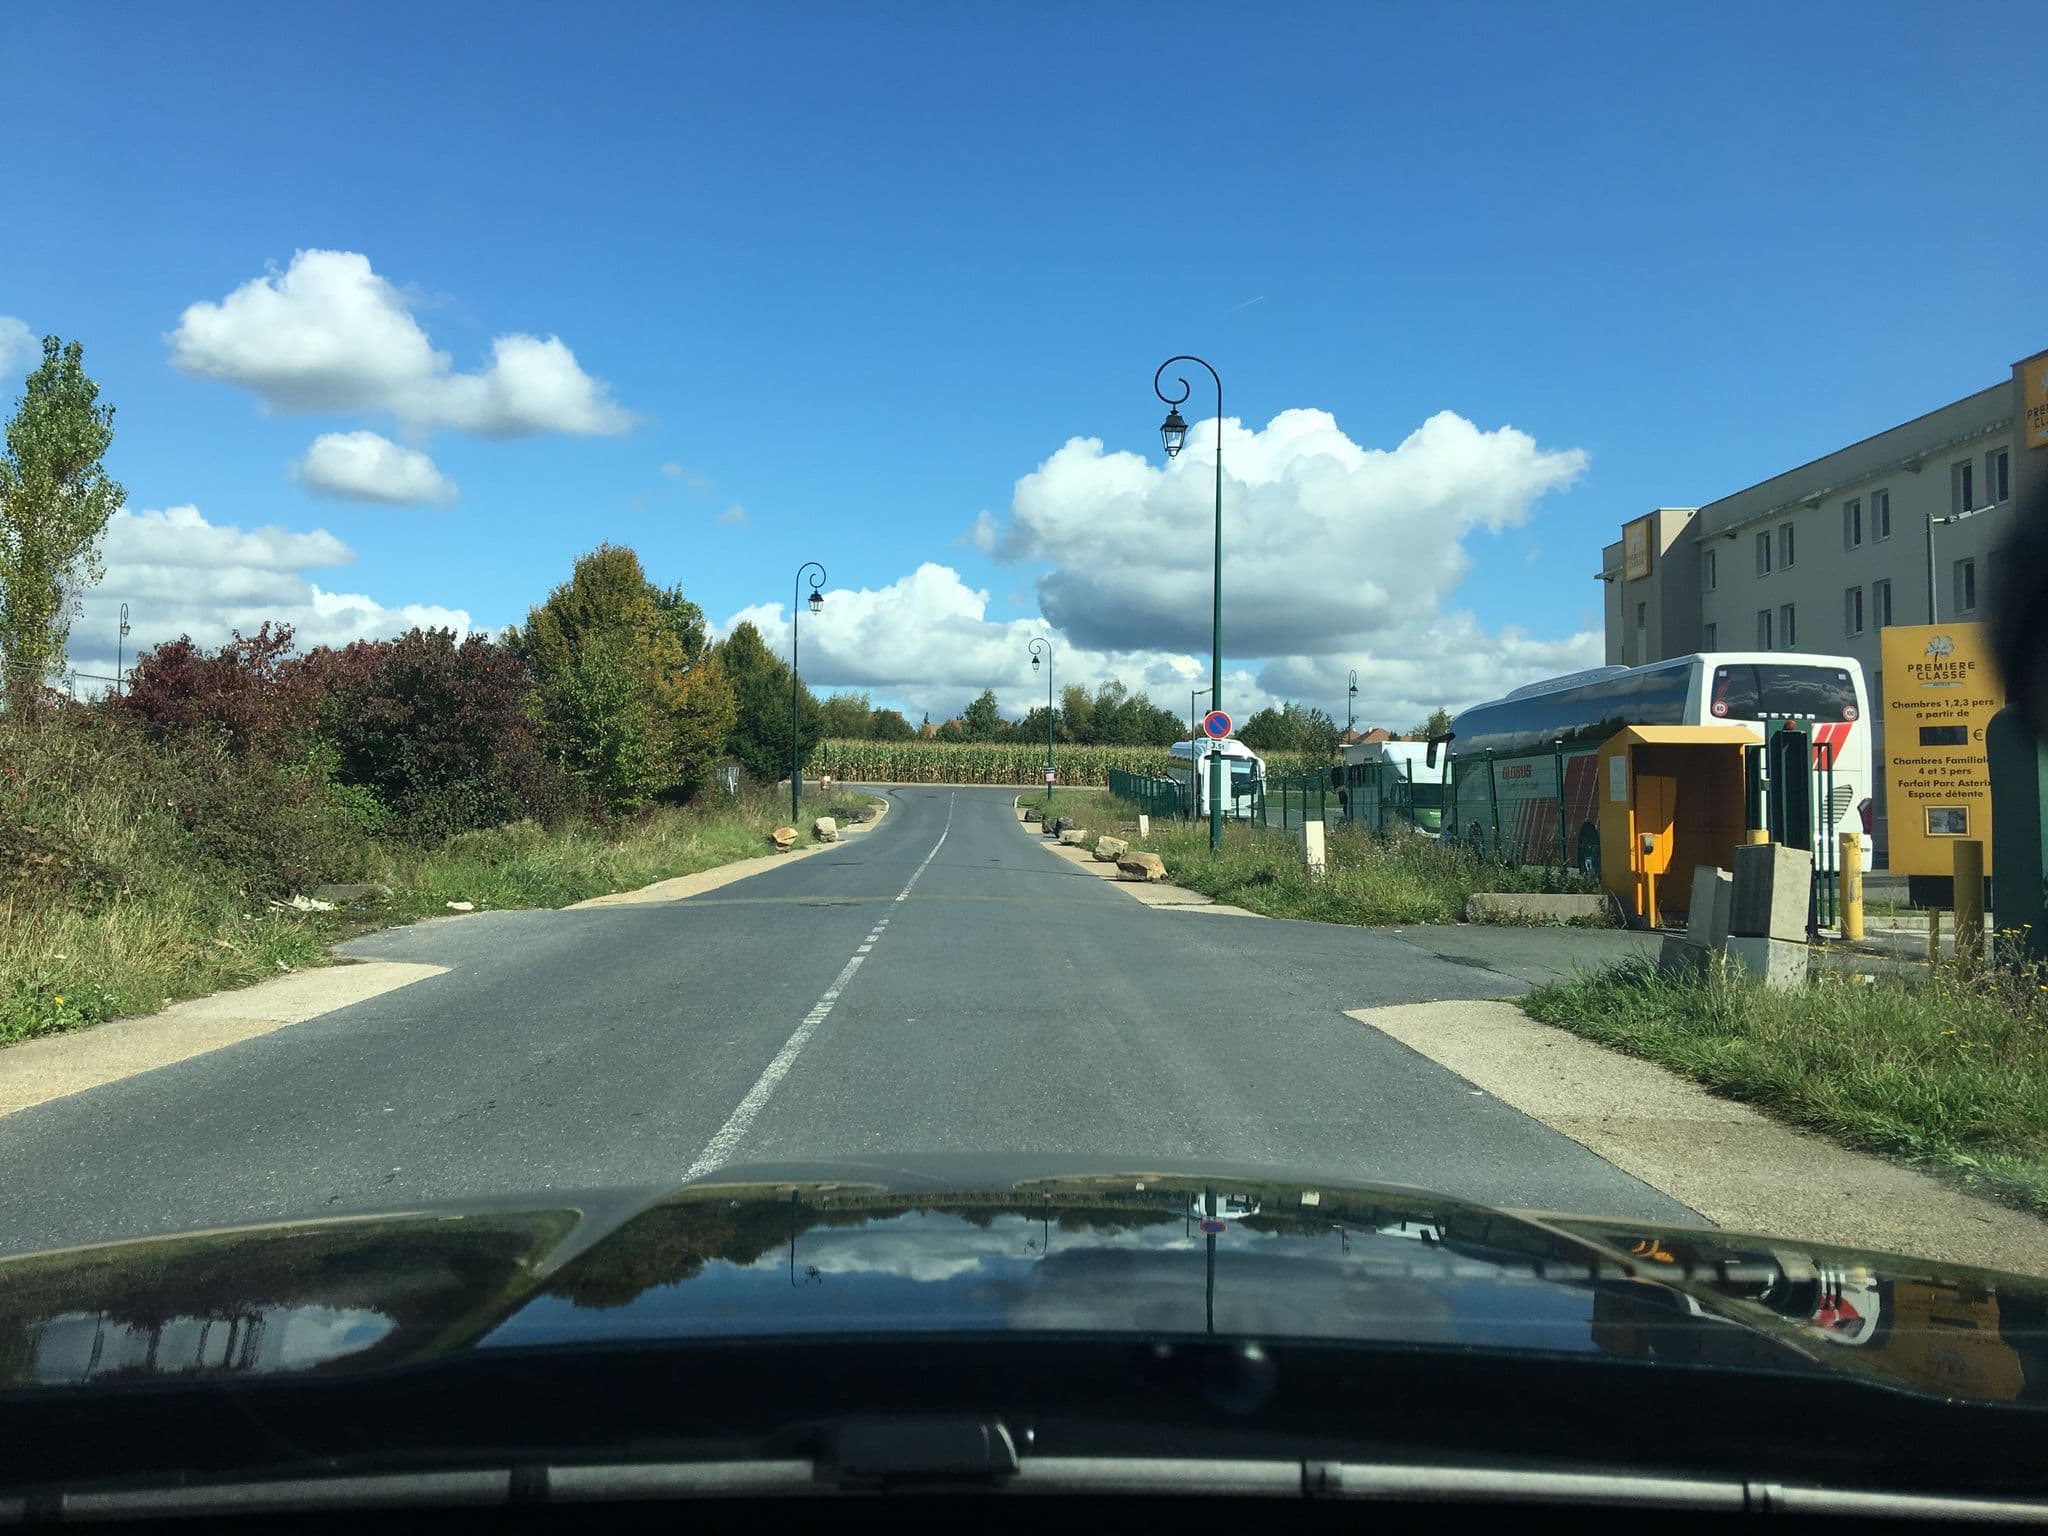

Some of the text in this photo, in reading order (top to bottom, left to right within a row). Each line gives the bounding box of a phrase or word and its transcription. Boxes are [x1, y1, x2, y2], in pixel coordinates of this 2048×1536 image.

[1907, 661, 1976, 672] PREMIERE
[1917, 671, 1967, 681] CLASSE
[1892, 699, 1994, 709] Chambres 1,2,3 pers
[1757, 712, 1816, 720] SETRA
[1926, 710, 1954, 719] partir
[1973, 728, 1983, 741] €
[1893, 755, 1988, 765] Chambres Familial
[1928, 767, 1938, 775] et
[1941, 767, 1947, 775] 5
[1949, 768, 1972, 777] pers
[1898, 779, 1931, 787] Forfait
[1933, 779, 1955, 787] Parc
[1908, 789, 1984, 800] Espace détente
